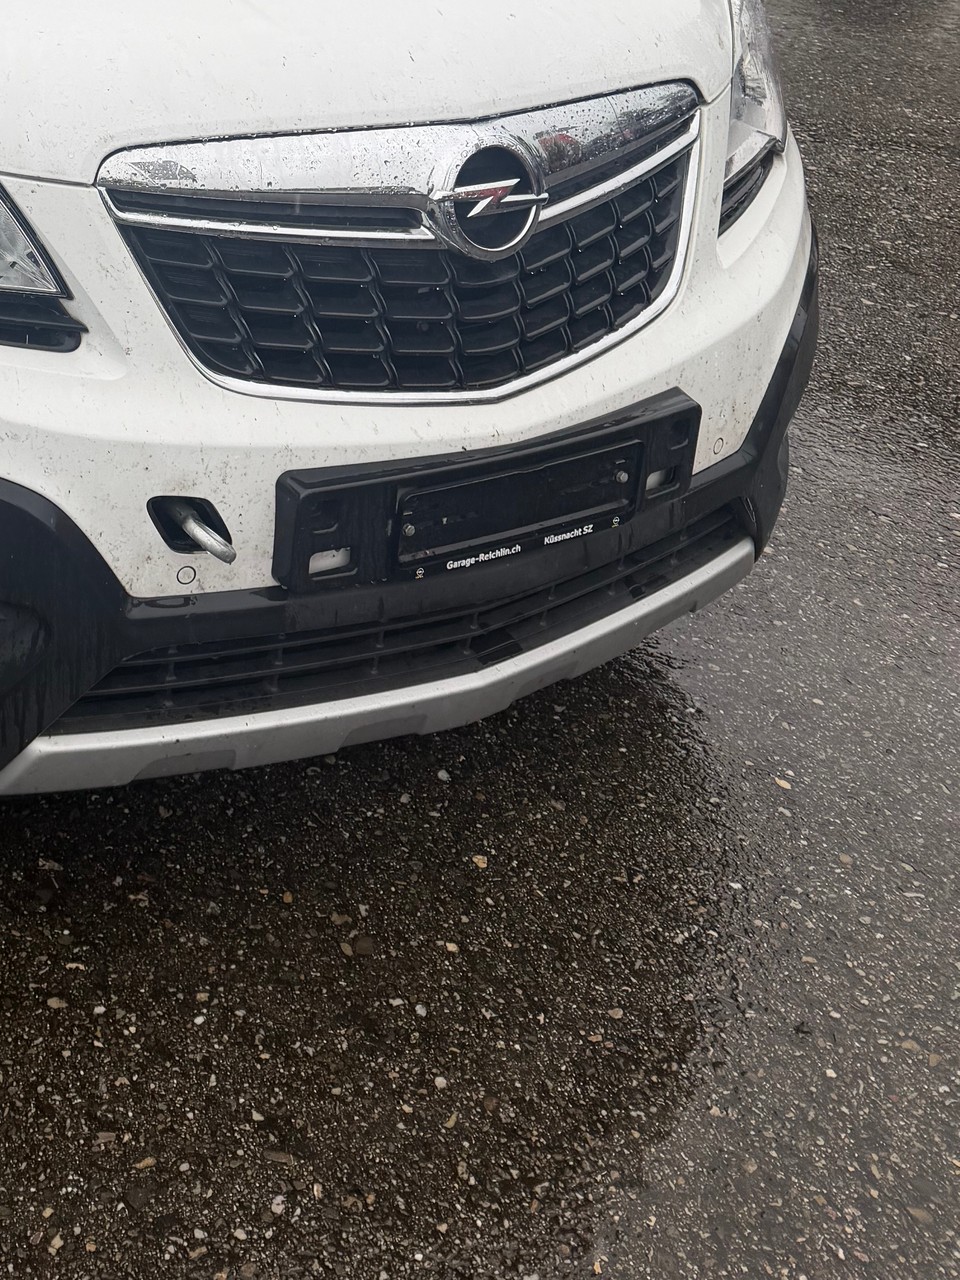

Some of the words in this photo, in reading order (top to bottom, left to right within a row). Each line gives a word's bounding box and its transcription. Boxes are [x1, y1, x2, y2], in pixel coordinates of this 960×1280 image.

[543, 528, 582, 545] Küssnacht
[582, 524, 594, 535] SZ
[446, 544, 521, 570] Garage-Reichlin.ch
